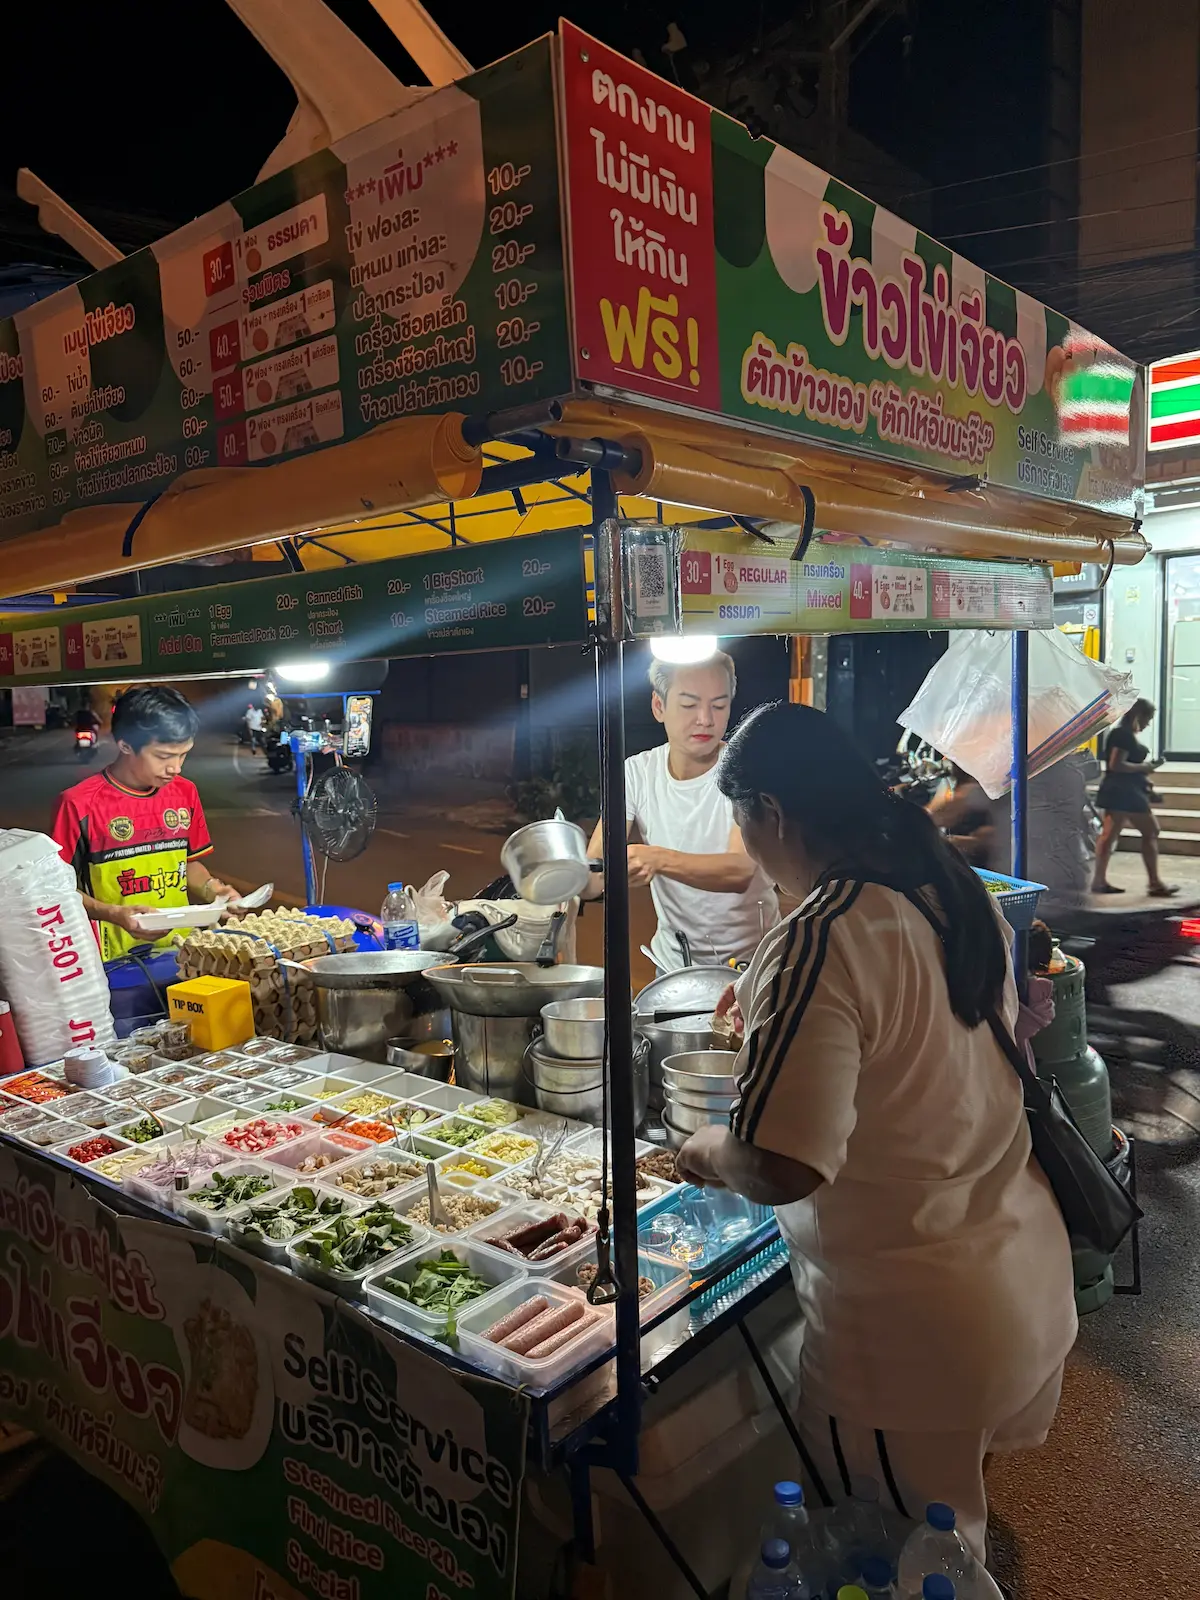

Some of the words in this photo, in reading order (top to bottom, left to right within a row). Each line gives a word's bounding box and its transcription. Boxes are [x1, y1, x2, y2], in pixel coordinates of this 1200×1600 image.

[592, 68, 695, 154] ตกงาน
[589, 126, 697, 226] ไม่มีเงิน
[346, 220, 362, 253] ไข่
[367, 207, 421, 244] ฟองละ
[488, 161, 531, 194] 10.-
[210, 260, 232, 284] 30.-
[236, 239, 242, 258] 1
[245, 235, 257, 249] ฟอง
[268, 214, 317, 251] ธรรมดา
[351, 258, 393, 286] แหนม
[395, 233, 448, 268] แท่งละ
[490, 201, 533, 234] 20.-
[610, 208, 688, 287] ให้กิน
[353, 269, 445, 321] ปลากระป๋อง
[492, 239, 535, 273] 20.-
[495, 278, 538, 309] 10.-
[64, 303, 135, 357] เมนูไข่เจียว
[215, 335, 238, 358] 40.-
[300, 293, 307, 313] 1
[497, 317, 540, 348] 20.-
[599, 286, 700, 387] ฟรี!
[816, 207, 1028, 414] ข้าวไข่เจียว
[0, 353, 24, 380] ป๋อง
[42, 388, 60, 403] 60.-
[178, 330, 200, 348] 50.-
[45, 414, 63, 428] 60.-
[180, 359, 202, 378] 60.-
[219, 387, 242, 410] 50.-
[246, 368, 254, 388] 2
[304, 345, 311, 368] 1
[361, 371, 479, 423] ข้าวเปล่าตักเอง
[501, 356, 543, 385] 10.-
[745, 341, 866, 430] ตักข้าวเอง
[47, 436, 66, 454] 70.-
[180, 386, 205, 409] 60.-
[49, 464, 69, 480] 60.-
[182, 415, 207, 439] 60.-
[223, 434, 245, 457] 60.-
[249, 419, 257, 440] 2
[306, 400, 313, 422] 1
[1018, 425, 1039, 453] Self
[1040, 434, 1074, 464] Service
[53, 489, 71, 506] 60.-
[185, 446, 210, 469] 60.-
[306, 587, 344, 606] Canned
[345, 584, 363, 601] fish
[387, 579, 411, 595] 20.-
[432, 567, 484, 590] BigShort
[522, 558, 552, 577] 20.-
[686, 560, 709, 583] 30.-
[715, 556, 721, 574] 1
[723, 559, 735, 572] Egg
[739, 567, 787, 583] REGULAR
[804, 557, 845, 579] ทรงเครื่อง
[853, 581, 869, 598] 40.-
[215, 604, 232, 619] Egg
[277, 594, 299, 611] 20.-
[308, 622, 316, 636] 1
[316, 620, 343, 636] Short
[390, 611, 414, 628] 10.-
[425, 604, 477, 625] Steamed
[478, 602, 506, 619] Rice
[523, 597, 556, 616] 20.-
[719, 605, 761, 619] ธรรมดา
[806, 589, 842, 610] Mixed
[68, 639, 81, 654] 60.-
[158, 636, 183, 655] Add
[183, 634, 202, 652] On
[210, 630, 255, 647] Fermented
[255, 627, 276, 641] Pork
[279, 625, 299, 639] 20.-
[36, 904, 84, 982] JT-501
[173, 999, 185, 1009] TIP
[187, 1001, 204, 1014] BOX
[284, 1332, 359, 1405] Self
[361, 1369, 512, 1509] Service
[280, 1400, 506, 1578] บริการตัวเอง
[282, 1458, 382, 1526] Steamed
[383, 1508, 428, 1556] Rice
[426, 1538, 475, 1589] 20.-
[327, 1529, 384, 1571] Rice
